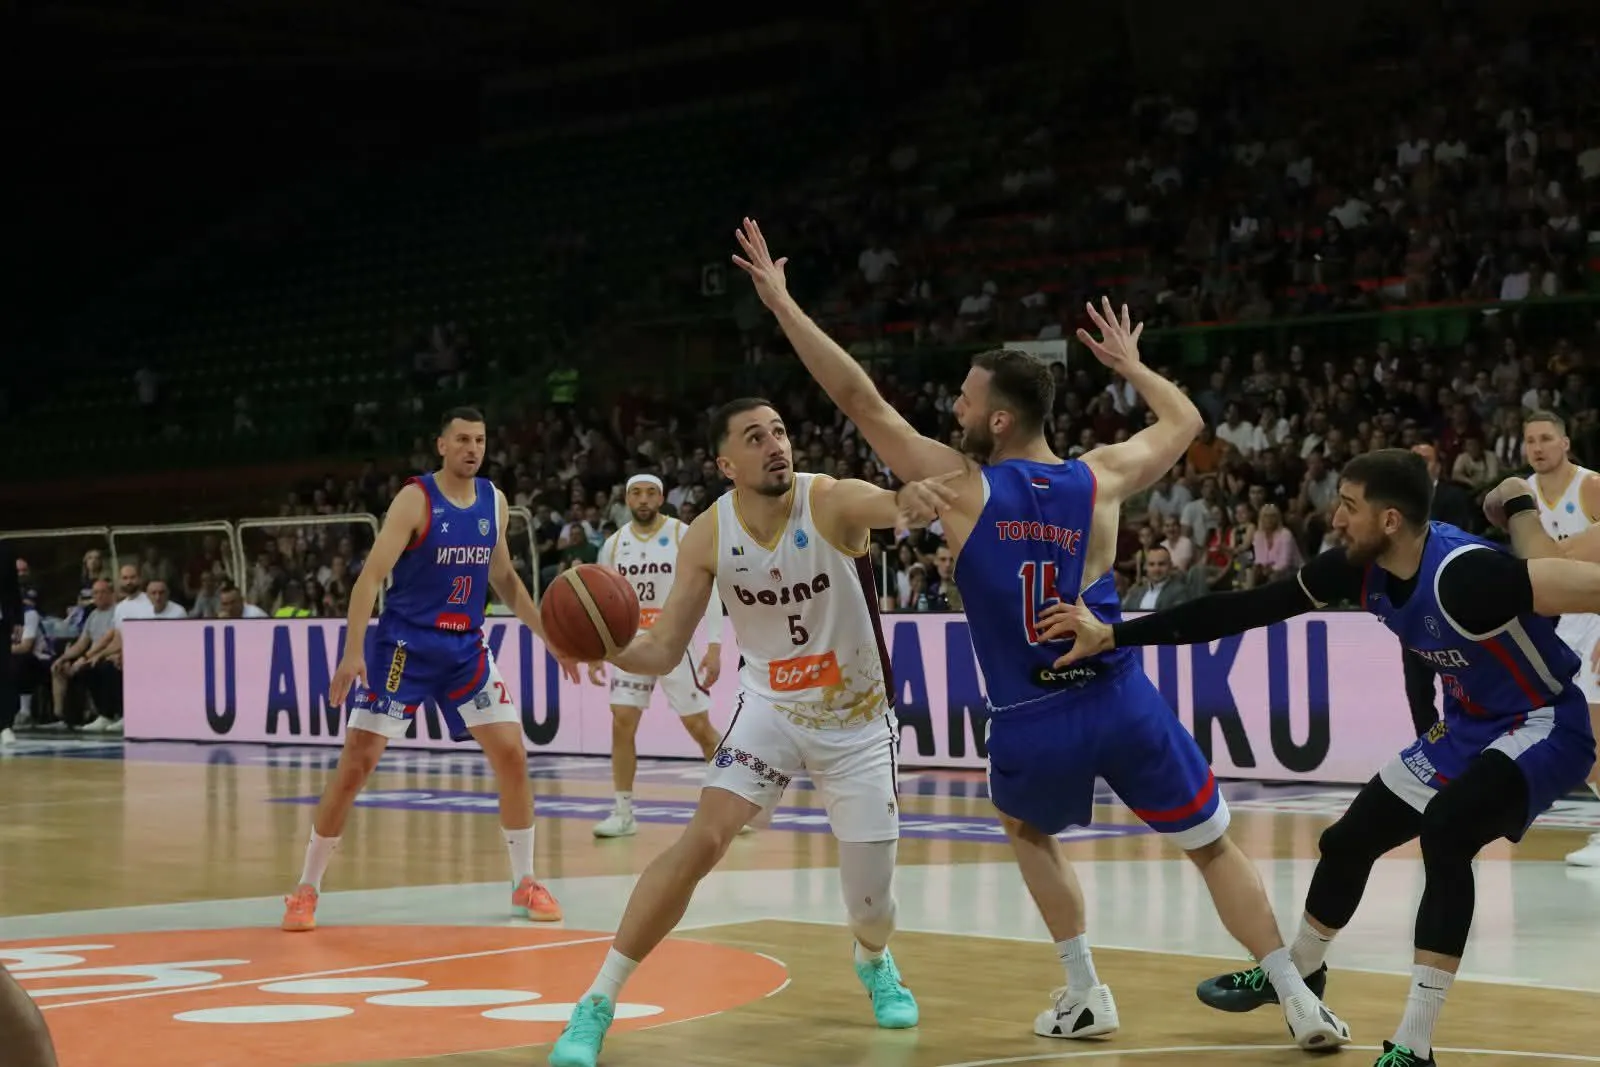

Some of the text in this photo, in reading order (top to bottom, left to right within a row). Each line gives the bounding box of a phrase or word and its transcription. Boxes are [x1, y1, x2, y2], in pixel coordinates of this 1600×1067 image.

[617, 562, 672, 576] bosna
[447, 575, 472, 604] 21
[637, 582, 655, 602] 23
[733, 572, 831, 606] bosna
[787, 614, 809, 646] 5
[204, 626, 237, 735] U
